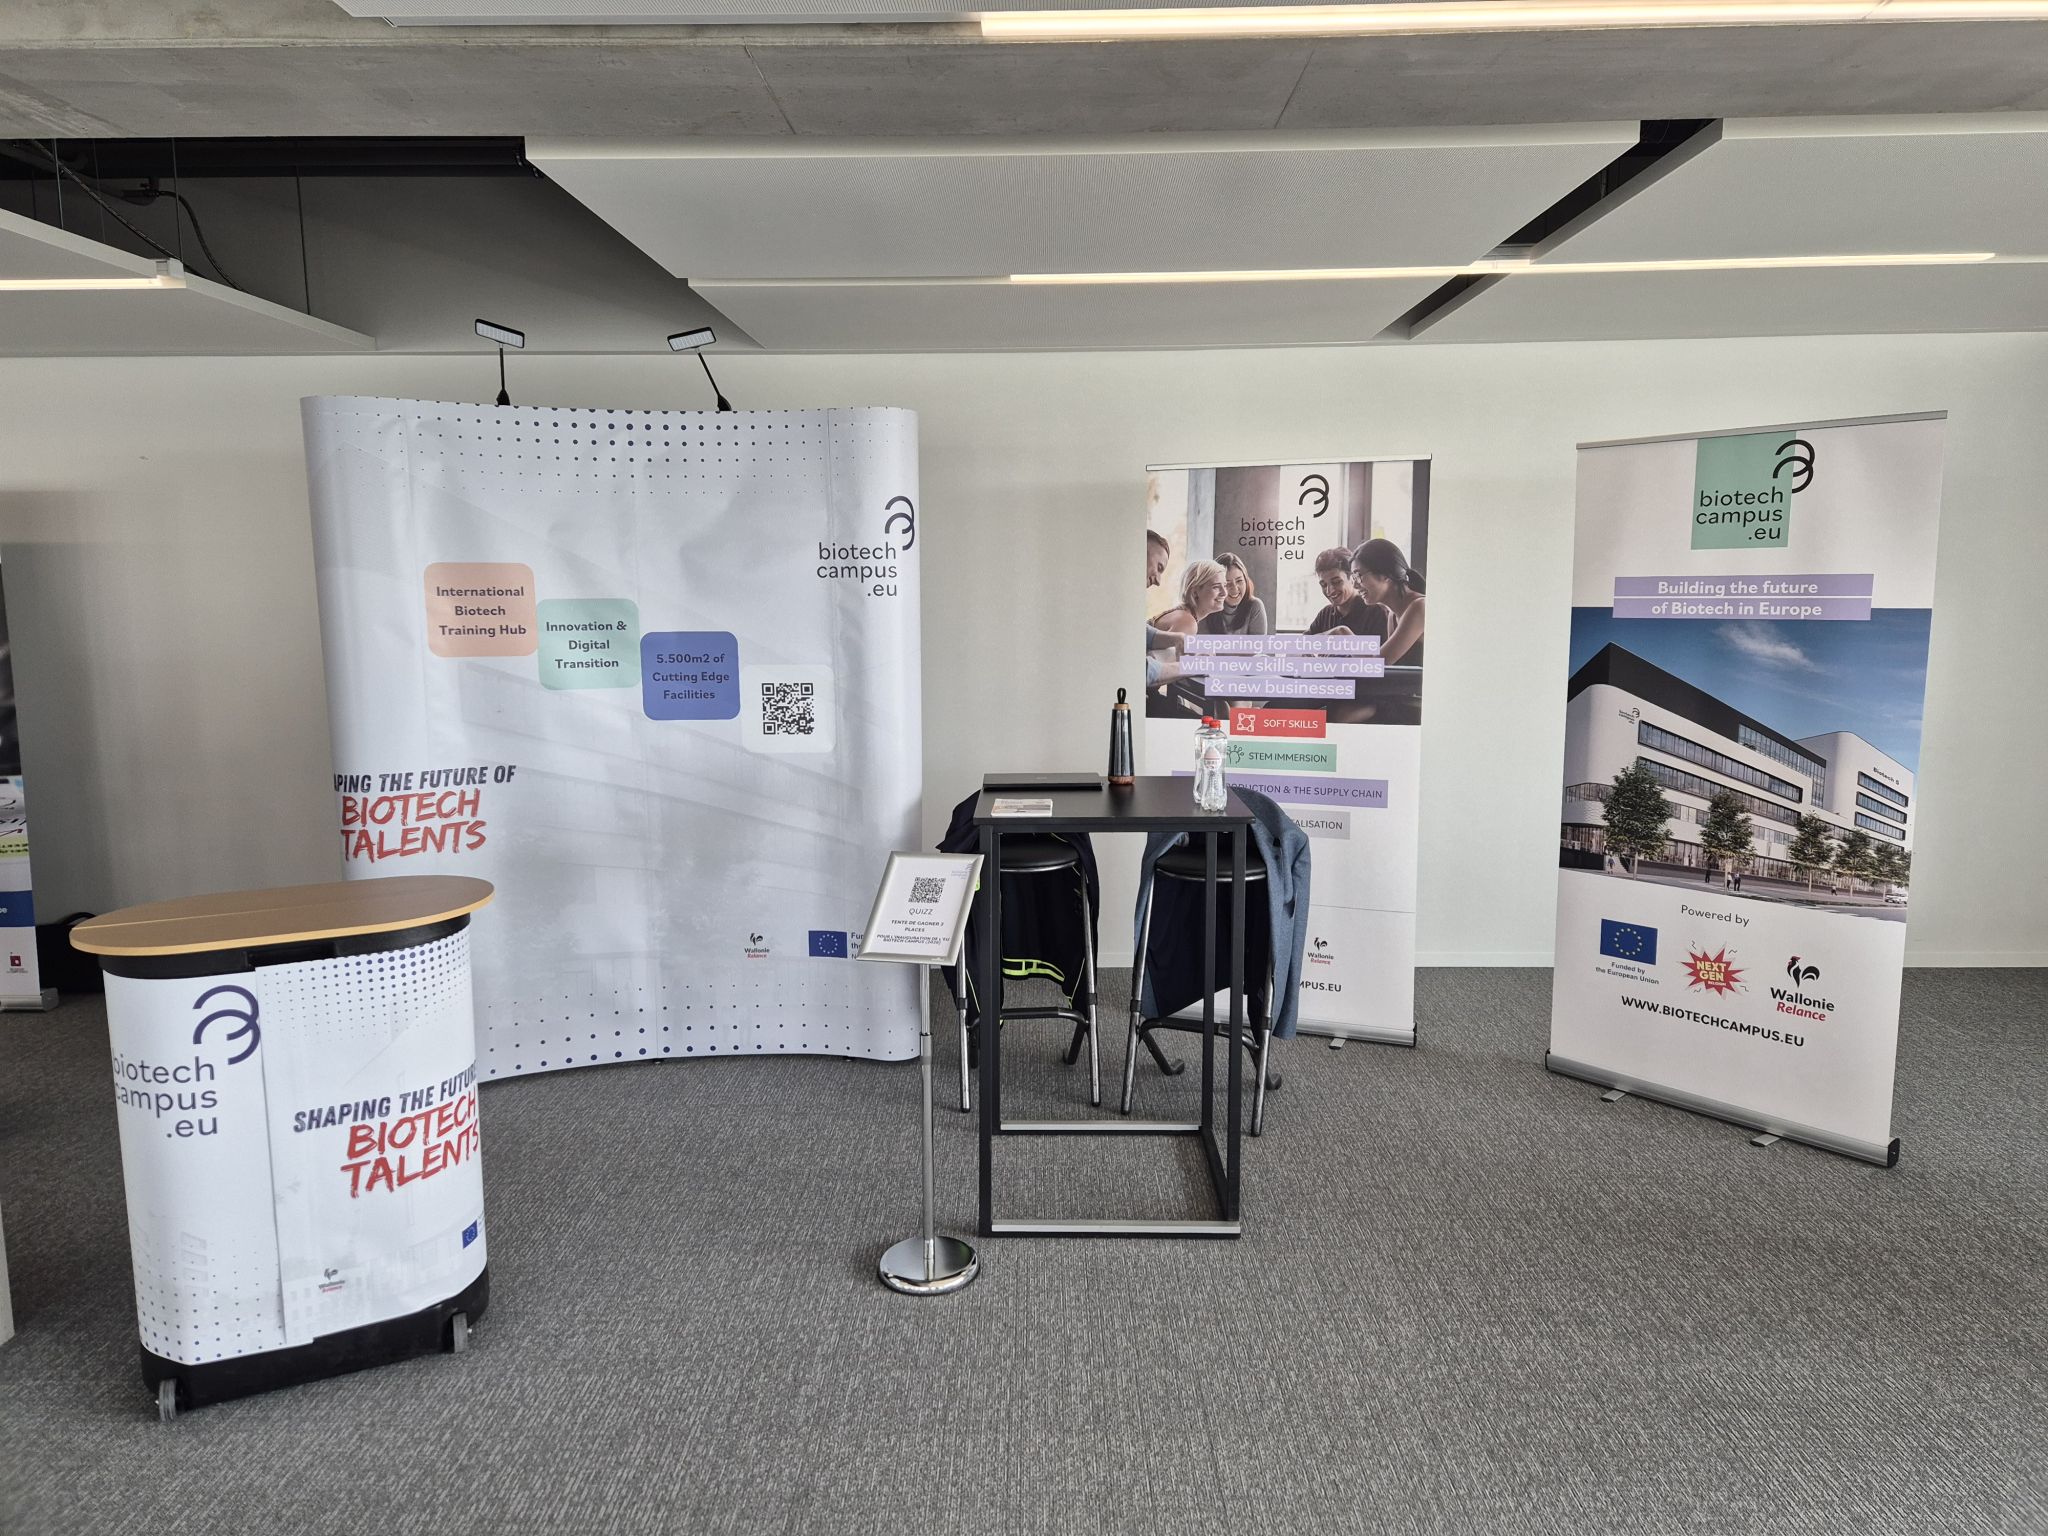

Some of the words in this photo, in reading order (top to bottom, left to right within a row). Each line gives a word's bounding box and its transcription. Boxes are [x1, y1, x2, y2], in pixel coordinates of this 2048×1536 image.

[1700, 486, 1783, 507] biotech
[1241, 516, 1304, 531] biotech
[1696, 509, 1783, 527] campus
[1748, 527, 1781, 540] .eu
[1239, 535, 1305, 549] campus
[819, 542, 896, 560] biotech
[1280, 550, 1304, 560] .eu
[817, 566, 897, 583] campus
[436, 586, 524, 597] International
[867, 584, 897, 596] .eu
[1658, 581, 1725, 597] Building
[1729, 581, 1758, 594] the
[1762, 581, 1819, 594] future
[455, 605, 506, 616] Biotech
[1651, 602, 1668, 615] of
[1671, 603, 1732, 616] Biotech
[1738, 602, 1755, 616] in
[1758, 603, 1823, 619] Europe
[439, 625, 496, 638] Training
[499, 624, 527, 635] Hub
[546, 621, 613, 632] Innovation
[616, 621, 627, 631] &
[568, 640, 610, 653] Digital
[1186, 636, 1263, 653] Preparing
[1268, 636, 1294, 650] for
[1296, 637, 1322, 650] the
[1326, 638, 1379, 651] future
[555, 658, 619, 669] Transition
[656, 653, 710, 664] 5.500m2
[713, 653, 726, 663] of
[1181, 658, 1213, 671] with
[1219, 661, 1252, 672] new
[1257, 658, 1299, 674] skills,
[1303, 662, 1337, 673] new
[1341, 661, 1382, 674] roles
[652, 672, 698, 684] Cutting
[701, 672, 730, 684] Edge
[1211, 679, 1224, 693] &
[1229, 682, 1261, 693] new
[1265, 679, 1353, 695] businesses
[663, 690, 716, 700] Facilities
[1263, 719, 1286, 728] SOFT
[1289, 720, 1318, 729] SKILLS
[1248, 752, 1273, 761] STEM
[1274, 753, 1328, 763] IMMERSION
[378, 772, 414, 792] THE
[419, 766, 489, 790] FUTURE
[493, 765, 517, 783] OF
[1283, 785, 1291, 794] &
[1294, 786, 1311, 795] THE
[1314, 788, 1350, 798] SUPPLY
[1352, 789, 1382, 799] CHAIN
[342, 788, 480, 827] BIOTECH
[1295, 819, 1343, 830] ALISATION
[340, 820, 487, 863] TALENTS
[1681, 904, 1732, 922] Powered
[1735, 911, 1750, 927] by
[1308, 951, 1335, 960] Wallonie
[1611, 962, 1636, 971] Funded
[1637, 967, 1646, 976] by
[1696, 960, 1727, 973] NEXT
[1607, 968, 1638, 981] European
[1640, 976, 1660, 985] Union
[1699, 970, 1724, 981] GEN
[1770, 987, 1835, 1011] Wallonie
[1776, 1001, 1826, 1021] Relance
[1621, 995, 1805, 1047] WWW.BIOTECHCAMPUS.EU
[293, 1096, 391, 1133] SHAPING
[399, 1086, 434, 1113] THE
[166, 1117, 218, 1137] .eu
[347, 1087, 476, 1160] BIOTECH
[340, 1118, 479, 1199] TALENTS
